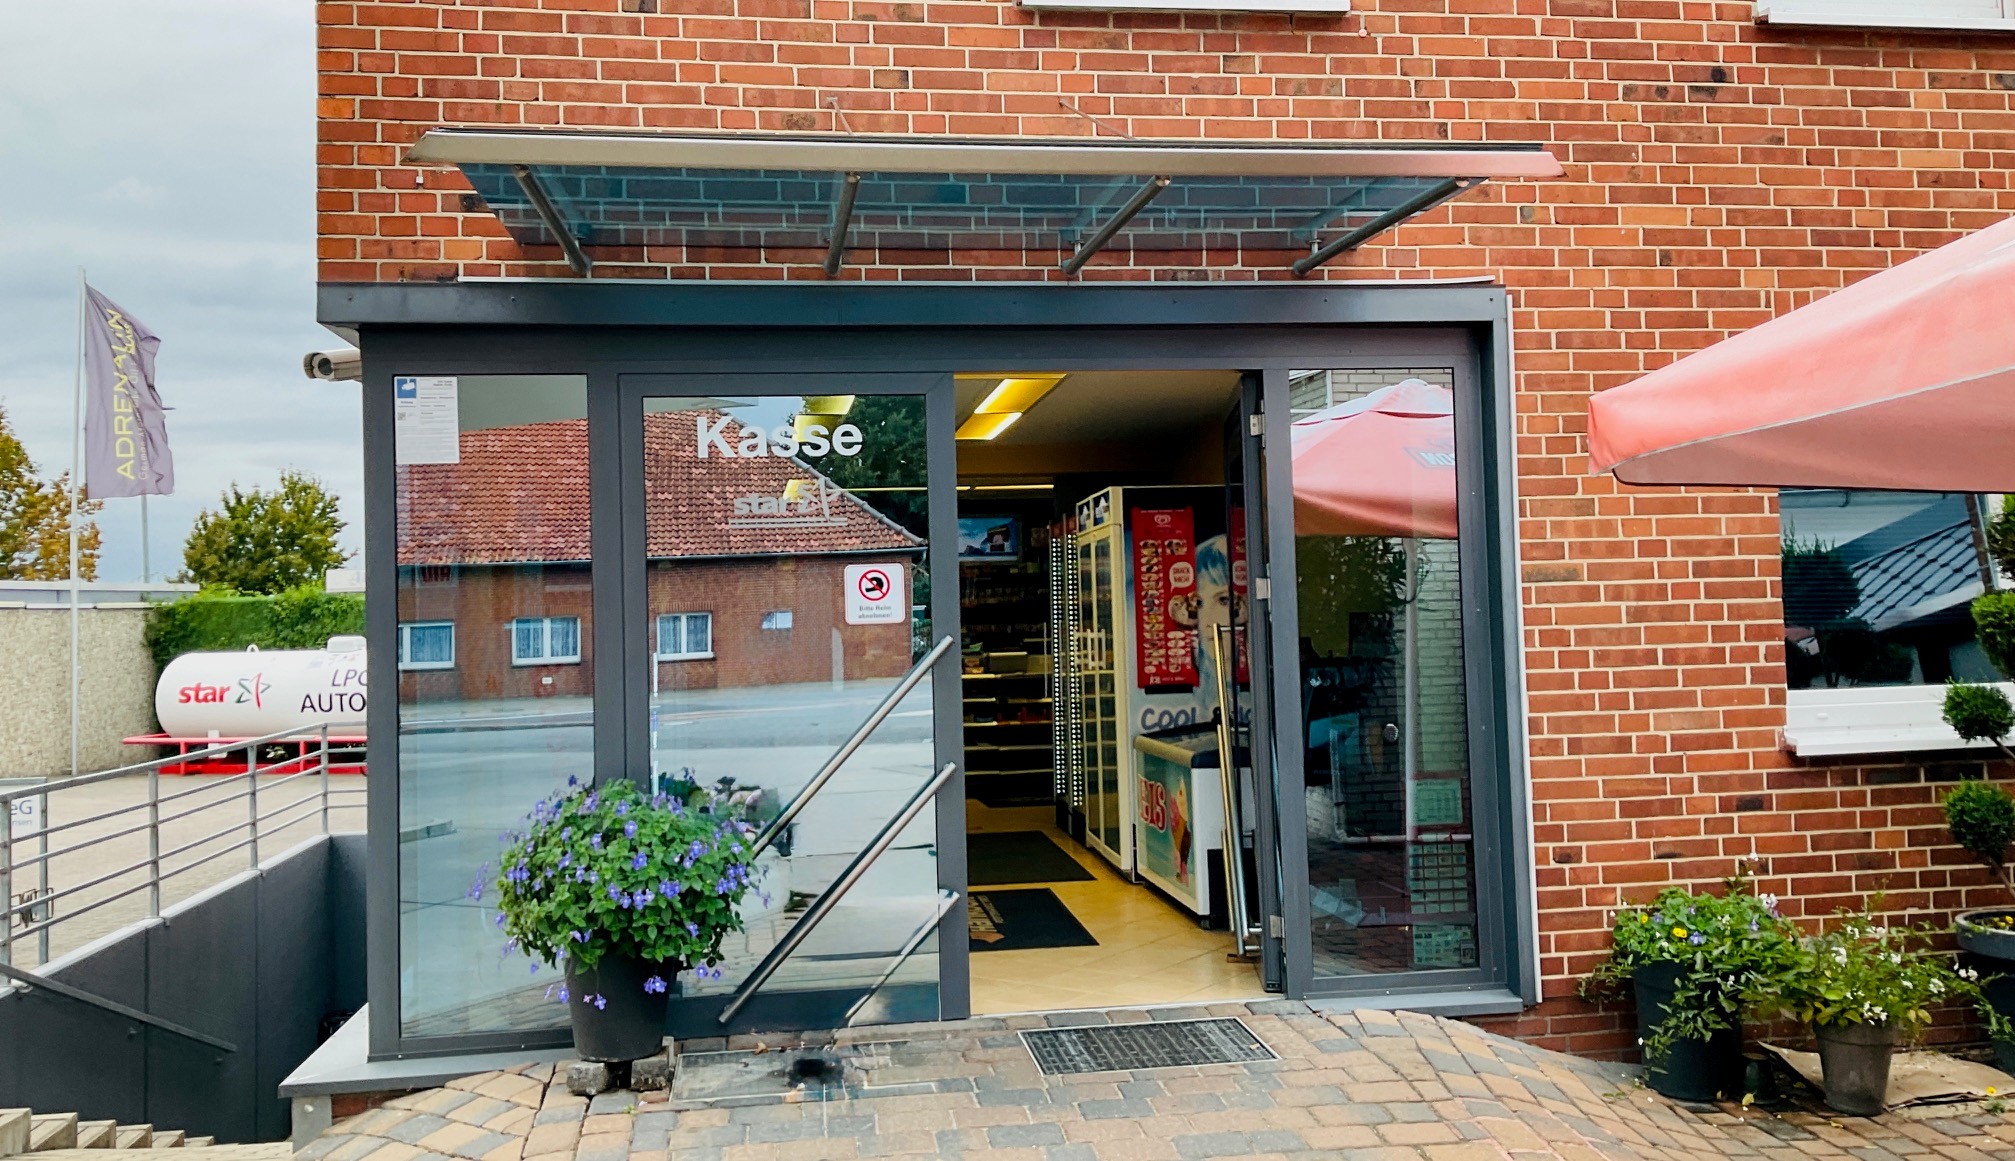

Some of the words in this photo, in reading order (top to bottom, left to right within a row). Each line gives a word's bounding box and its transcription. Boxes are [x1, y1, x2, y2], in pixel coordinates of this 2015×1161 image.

[696, 416, 863, 459] Kasse
[734, 492, 791, 515] star
[178, 682, 231, 704] star
[301, 693, 367, 713] AUTO
[1137, 775, 1167, 832] EIS
